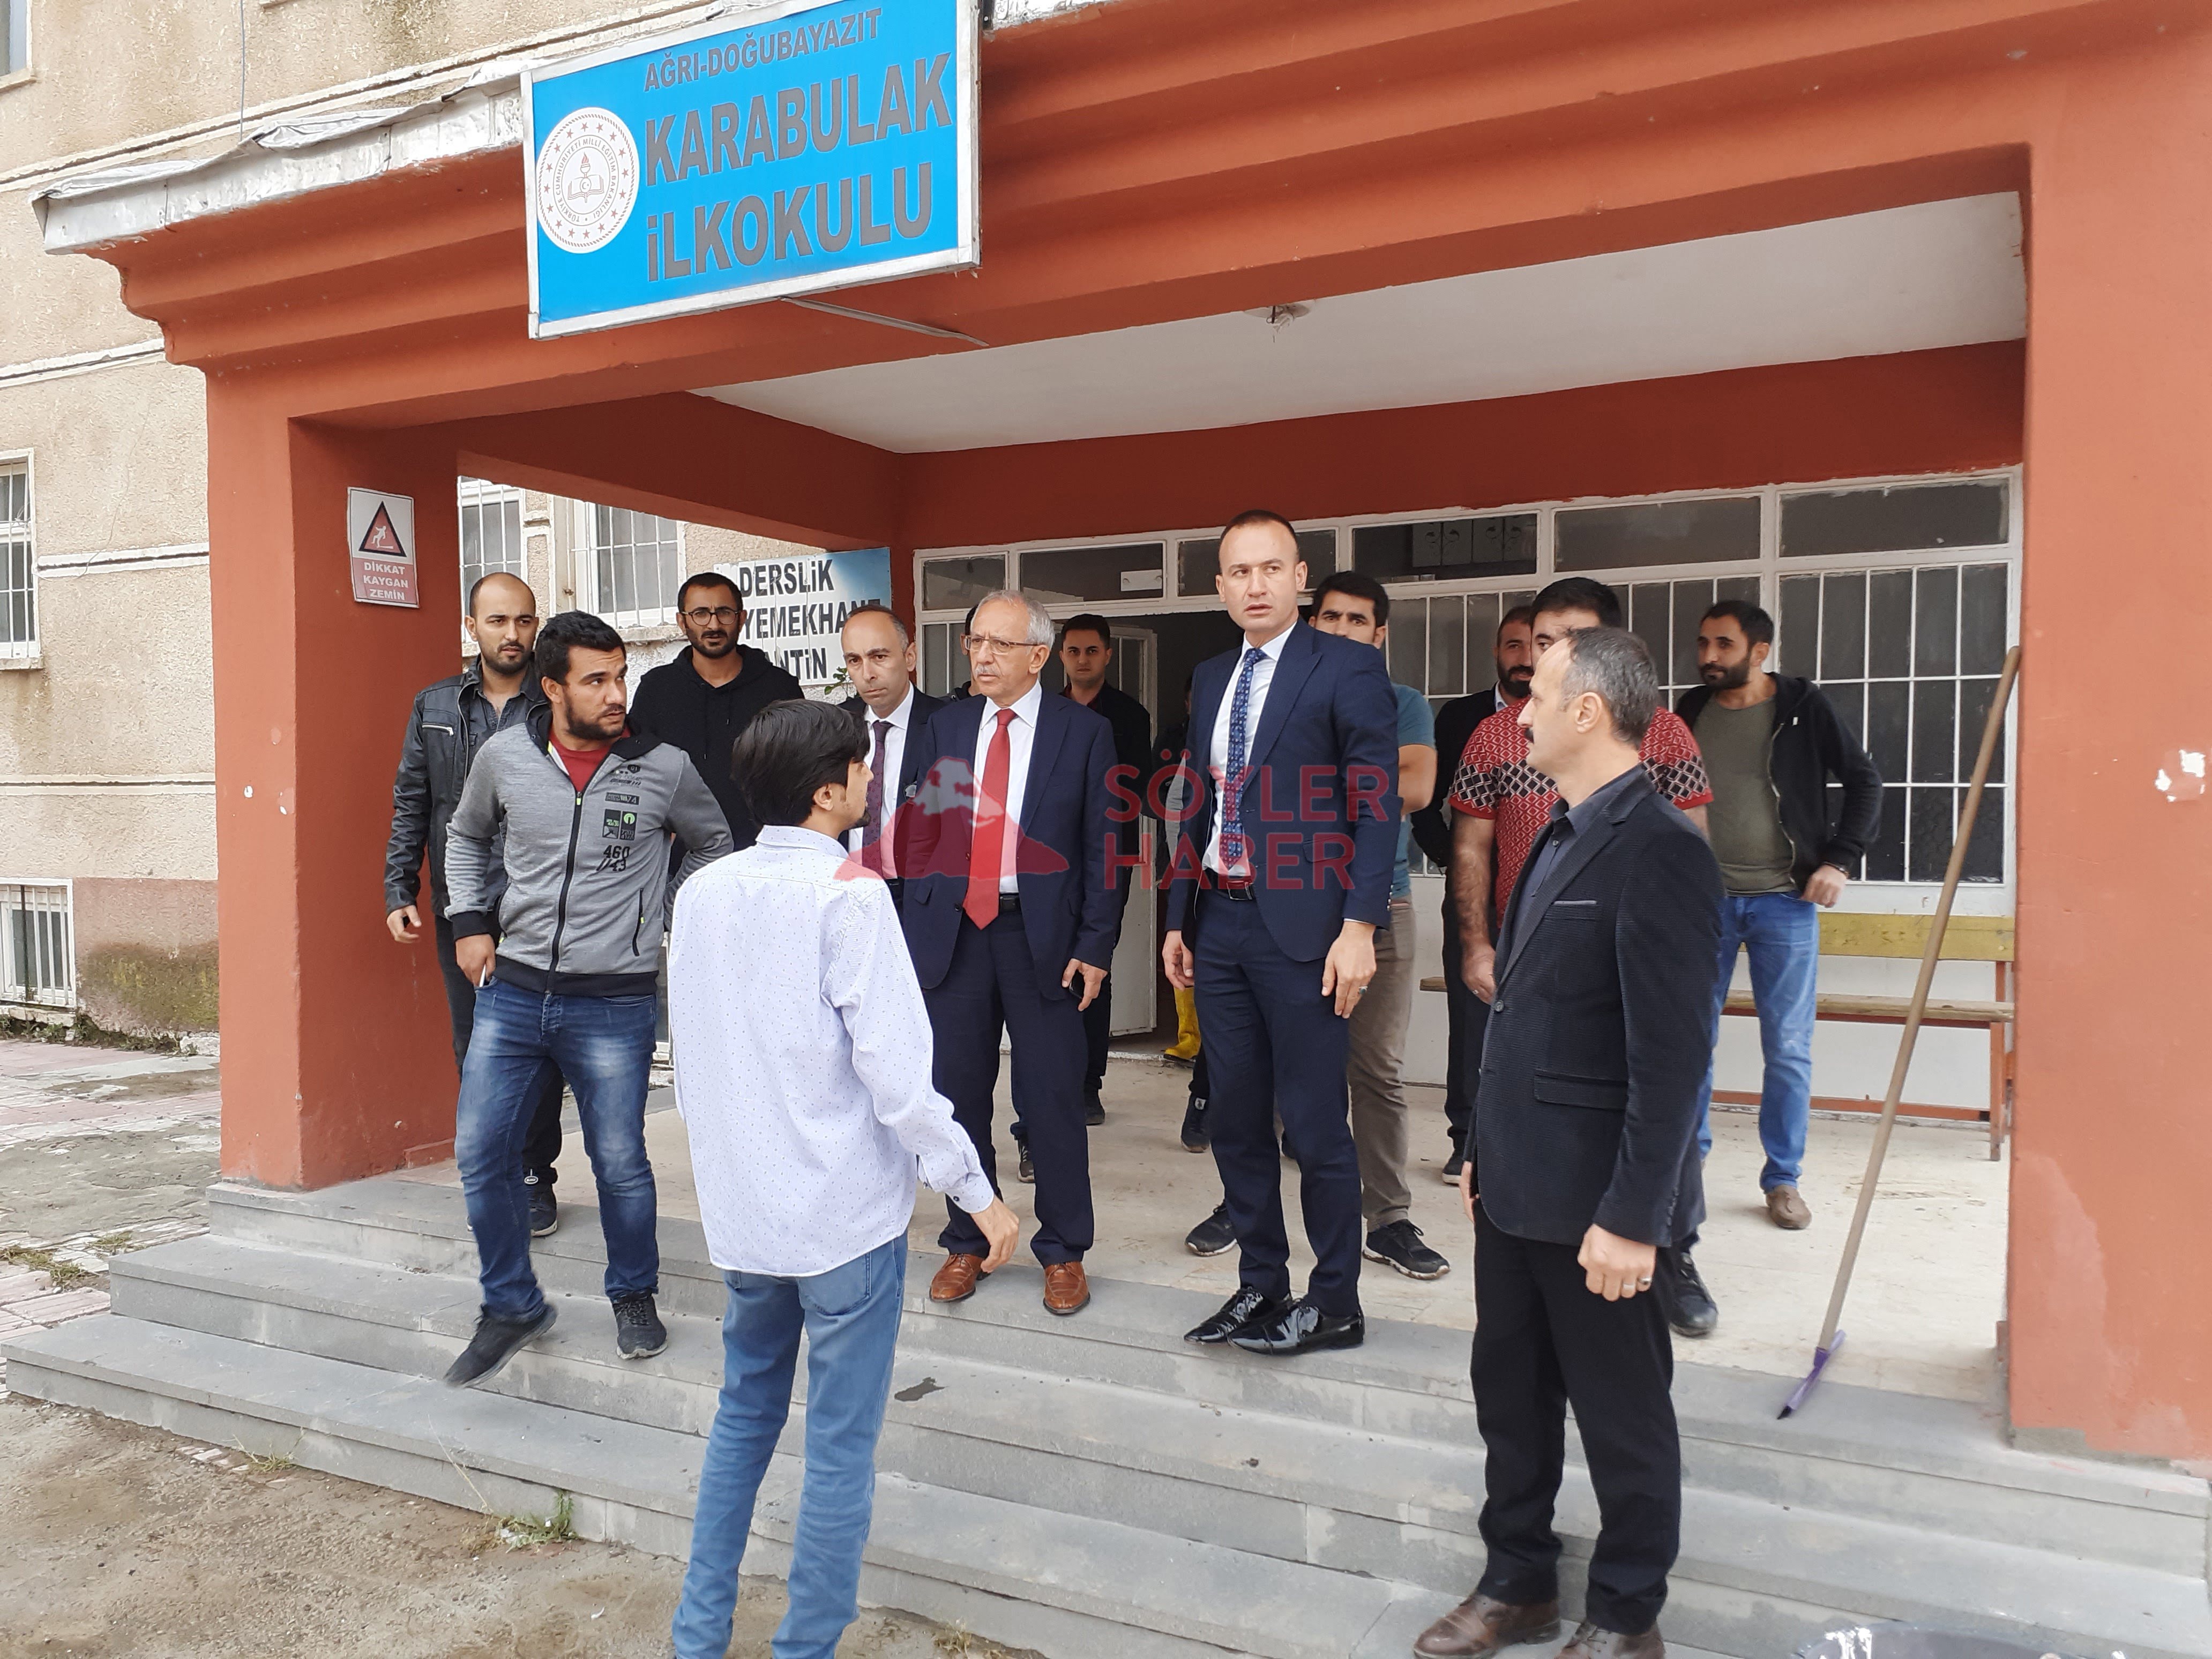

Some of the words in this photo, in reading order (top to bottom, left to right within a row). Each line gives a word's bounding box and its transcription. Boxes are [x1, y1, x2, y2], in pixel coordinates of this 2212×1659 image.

[644, 8, 882, 92] AĞRI-DOĞUBAYAZIT
[646, 52, 952, 186] KARABULAK
[364, 562, 405, 575] DİKKAT
[363, 575, 408, 588] KAYGAN
[370, 589, 405, 601] ZEMİN
[744, 599, 880, 640] YEMEKHA
[603, 845, 630, 859] 460
